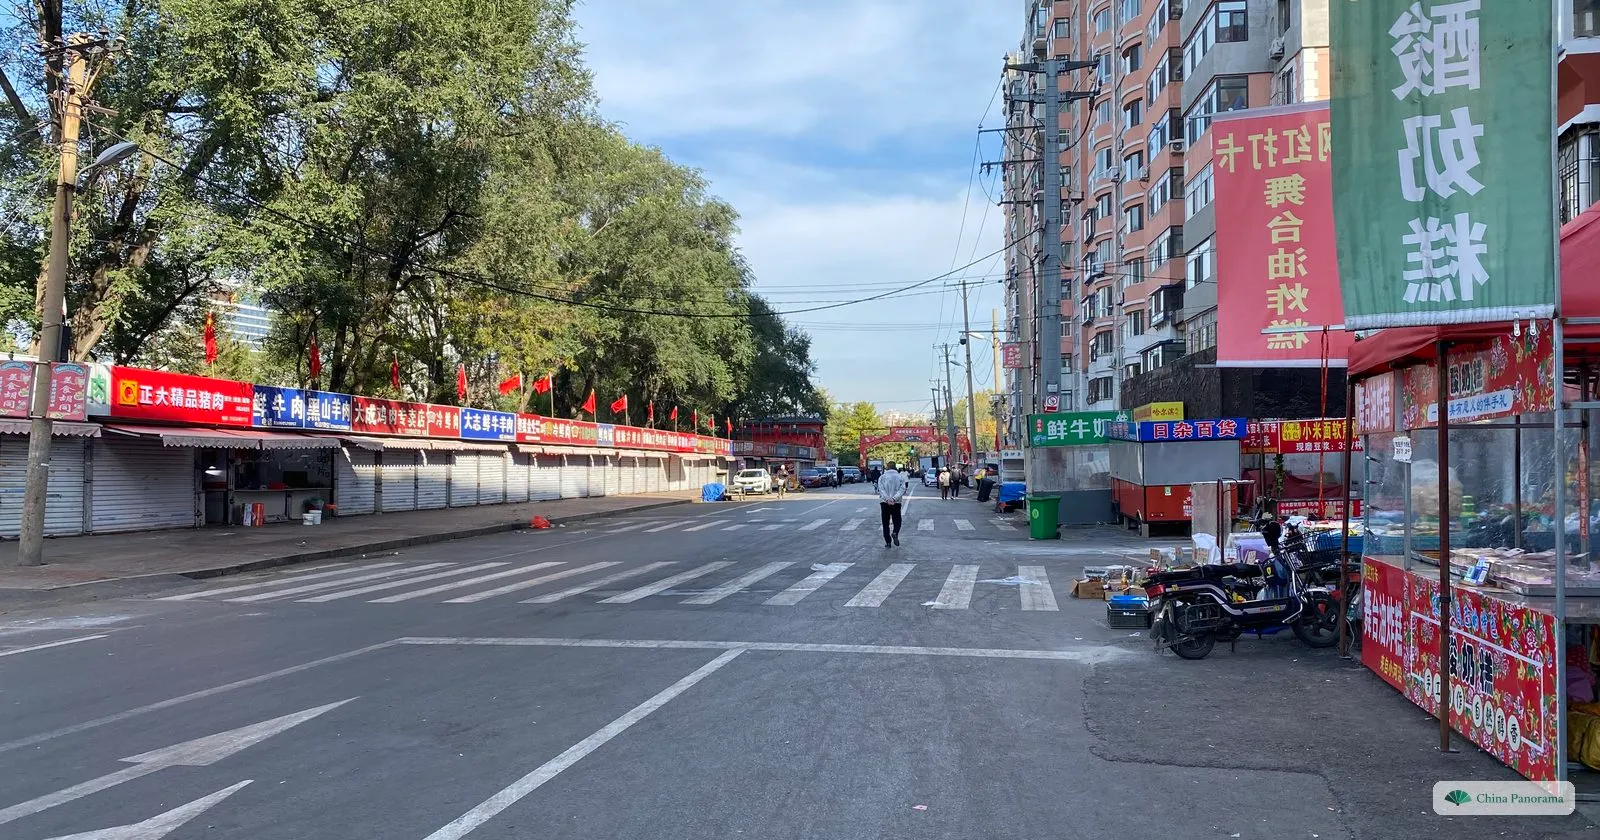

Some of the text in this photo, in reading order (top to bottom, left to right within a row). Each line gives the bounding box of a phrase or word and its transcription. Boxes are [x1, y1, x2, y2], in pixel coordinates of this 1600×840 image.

[139, 385, 224, 411] 正大精品猪肉
[252, 391, 303, 419] 鲜牛肉
[307, 397, 350, 422] 黑山羊肉
[354, 402, 426, 428] 大成鸡肉专卖店
[464, 412, 513, 433] 大志鲜牛羊肉
[1153, 419, 1237, 438] 日杂百货
[1363, 584, 1403, 657] 舞台油炸糕
